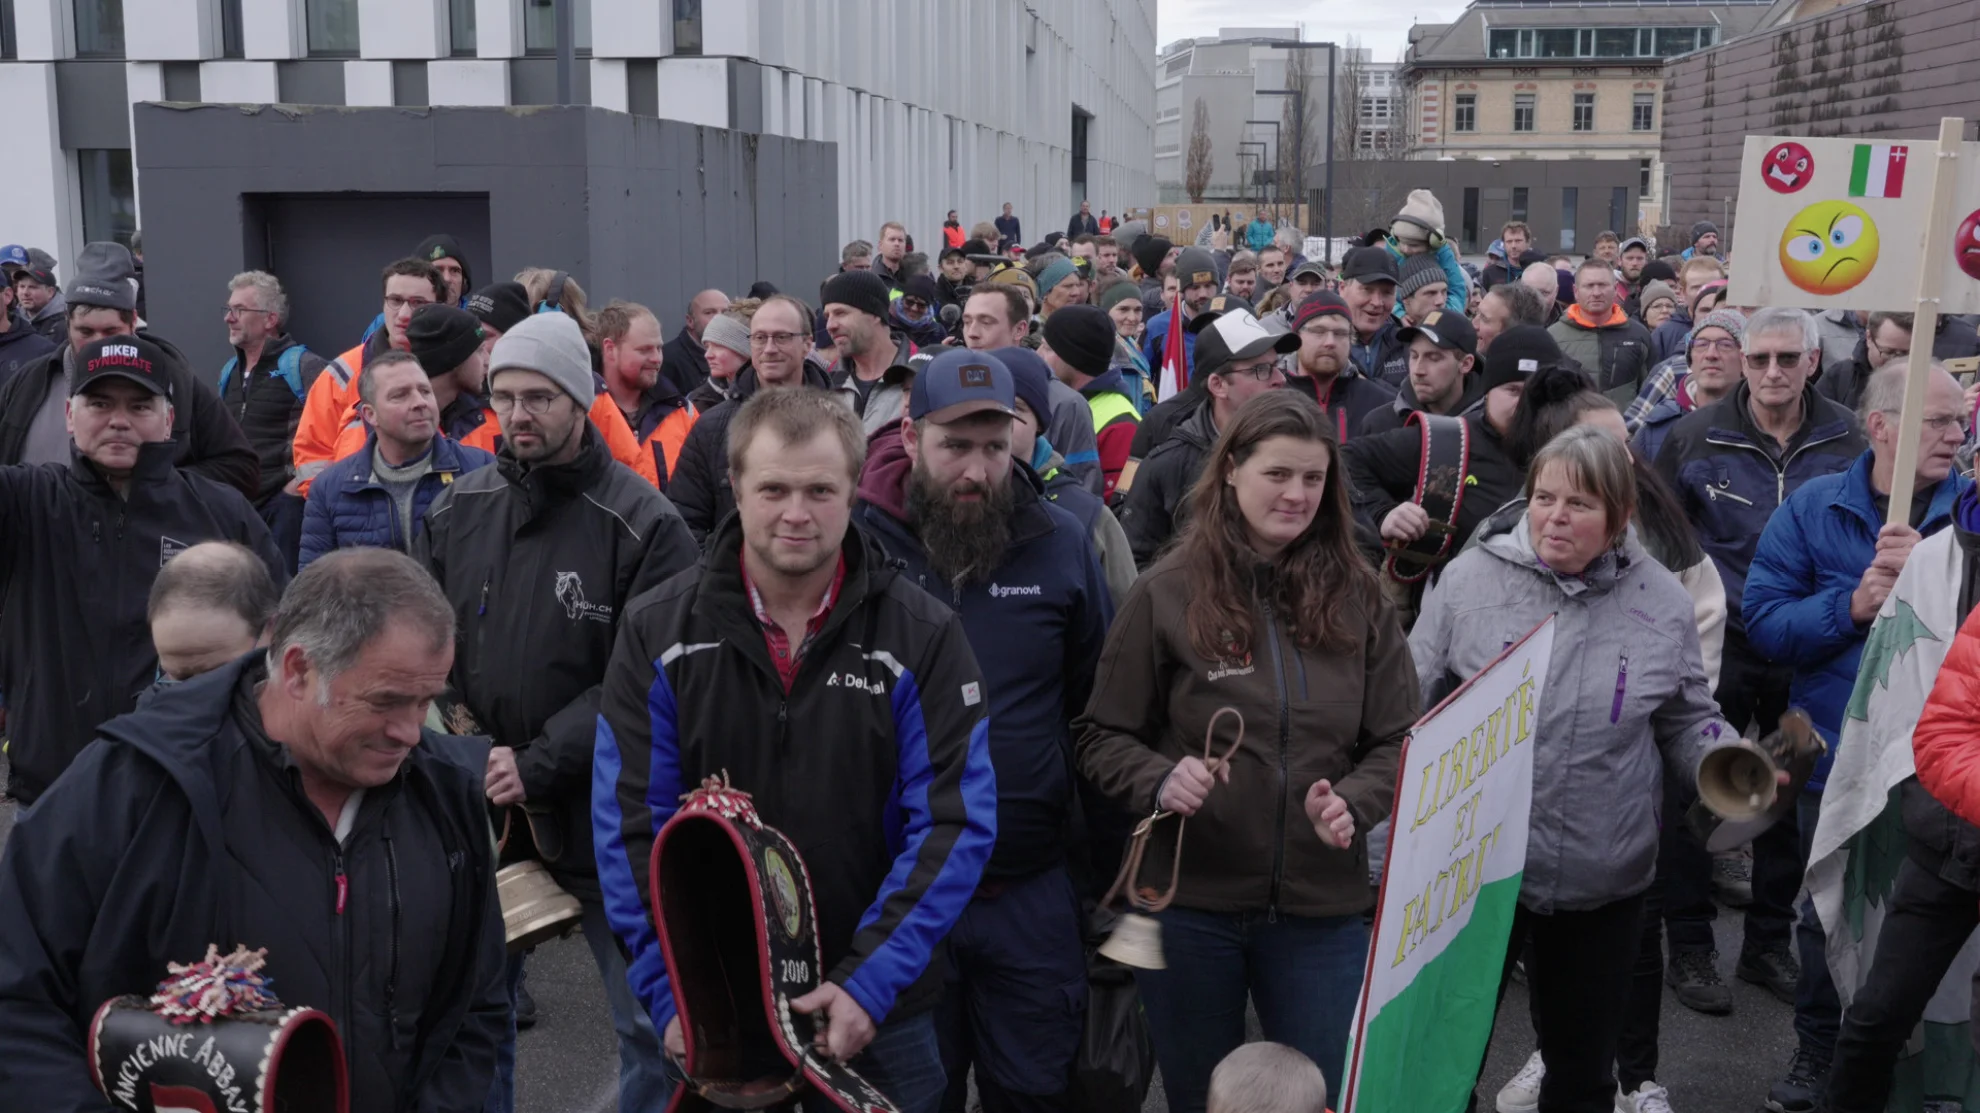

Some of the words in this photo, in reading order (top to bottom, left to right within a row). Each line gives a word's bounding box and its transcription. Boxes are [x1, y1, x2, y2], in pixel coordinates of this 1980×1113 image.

[102, 345, 138, 358] BIKER
[87, 356, 152, 374] SYNDICATE
[966, 370, 985, 382] CAT
[1000, 585, 1041, 597] granovit
[575, 600, 613, 613] HÜH.CH
[1410, 658, 1534, 833] LIBERTÉ
[1450, 786, 1483, 856] ET
[1391, 823, 1503, 969] PATRI
[780, 959, 809, 983] 2010
[112, 1033, 194, 1111] ANCIENNE
